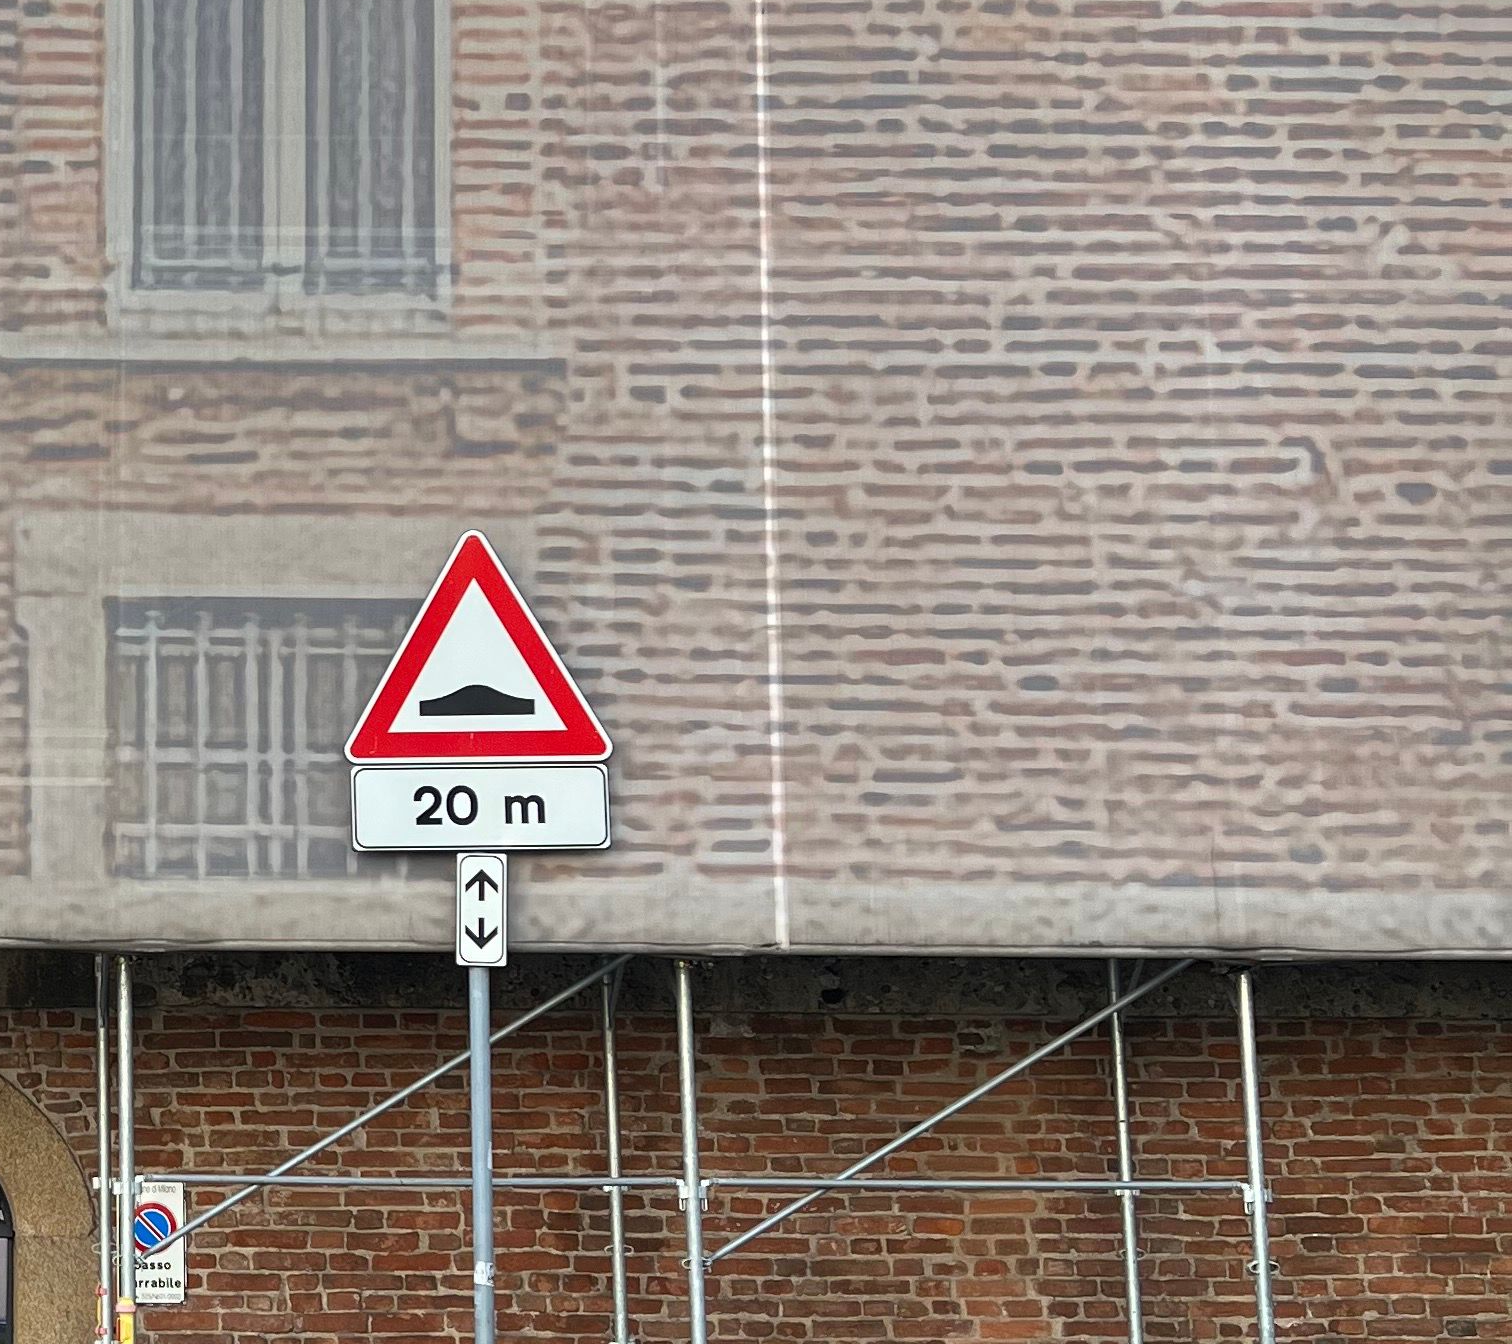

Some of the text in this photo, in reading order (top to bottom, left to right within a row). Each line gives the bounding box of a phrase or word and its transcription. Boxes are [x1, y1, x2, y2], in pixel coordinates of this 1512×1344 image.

[413, 785, 546, 826] 20 m
[135, 1277, 182, 1289] rrabile
